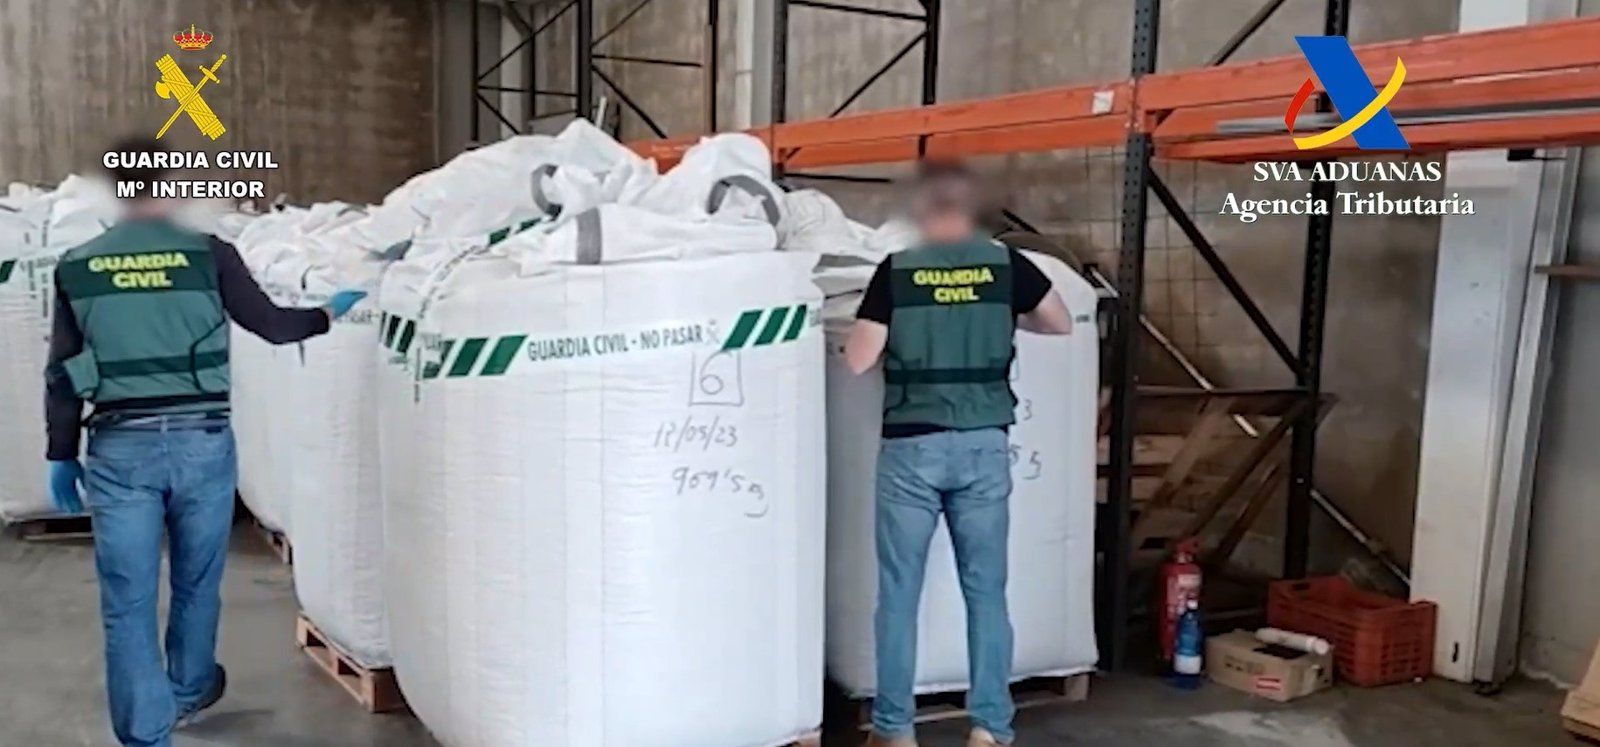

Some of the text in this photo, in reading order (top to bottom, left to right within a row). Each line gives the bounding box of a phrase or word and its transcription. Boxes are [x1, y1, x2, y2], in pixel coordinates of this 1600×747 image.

[88, 253, 189, 272] GUARDIA
[112, 271, 173, 288] CIVIL
[913, 267, 994, 286] GUARDIA
[934, 287, 980, 303] CIVIL
[528, 336, 592, 361] GUARDIA
[594, 331, 630, 354] CIVIL
[640, 328, 660, 350] NO
[662, 324, 704, 347] PASAR
[700, 350, 733, 396] 6
